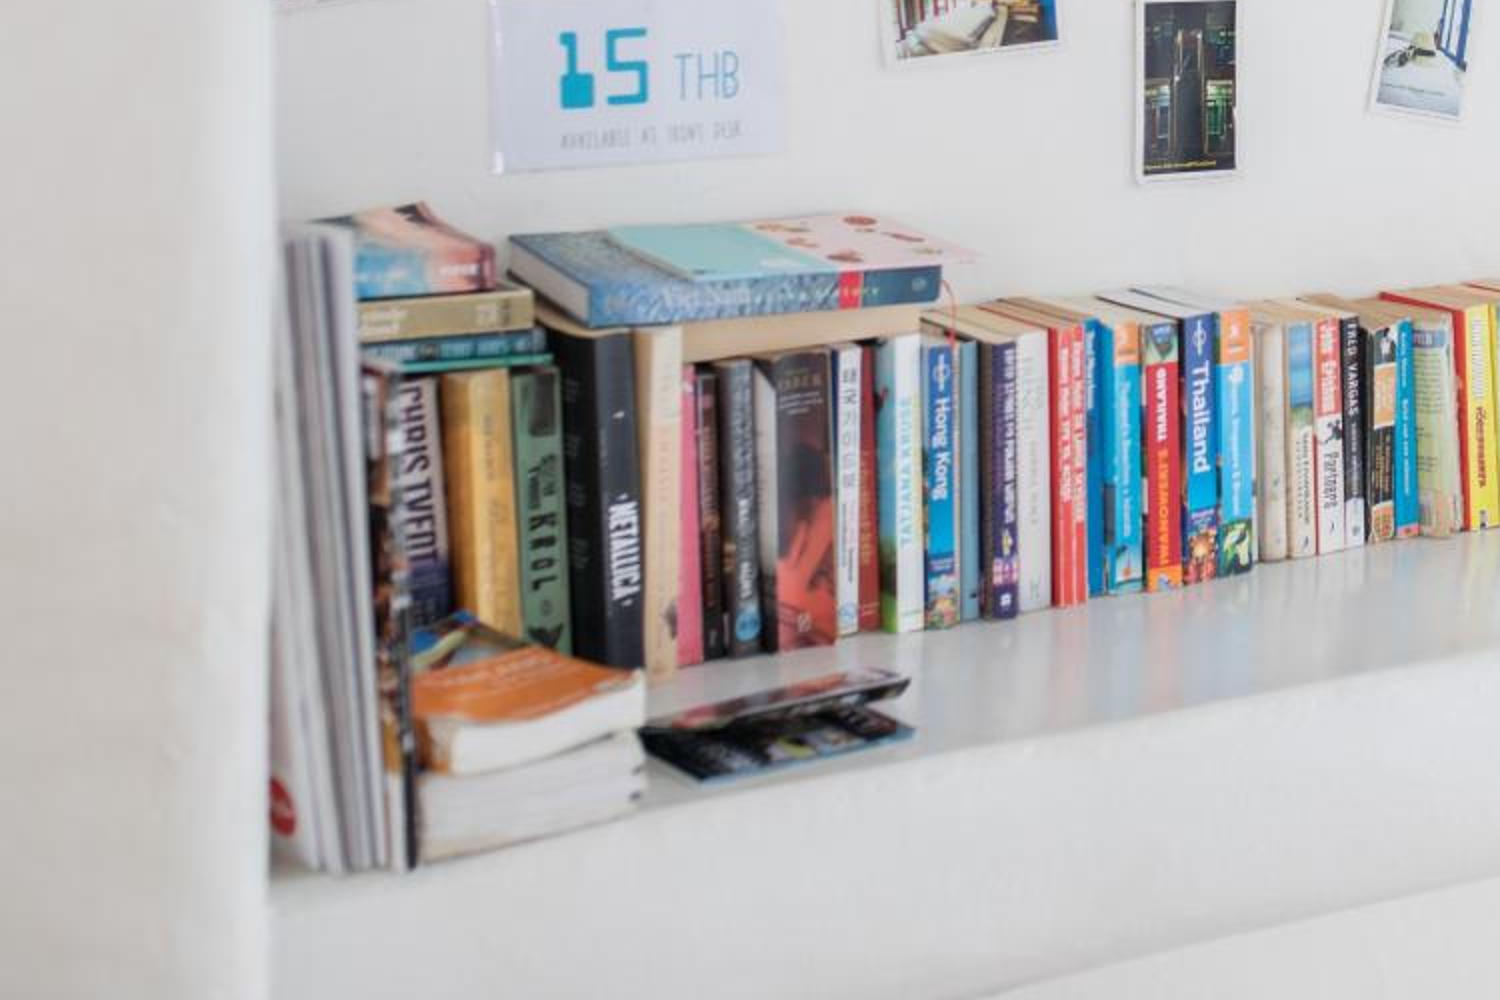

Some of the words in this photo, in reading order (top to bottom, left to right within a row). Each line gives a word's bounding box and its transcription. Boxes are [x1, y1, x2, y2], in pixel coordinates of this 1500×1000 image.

[559, 26, 648, 109] 15
[673, 49, 740, 101] THB
[932, 398, 951, 447] Hong
[1156, 366, 1169, 442] THAILAND
[1191, 360, 1211, 475] Thailand
[1347, 363, 1360, 417] VARGAS
[932, 452, 951, 500] Kong
[529, 512, 558, 592] KROL
[607, 500, 640, 602] METALLICA
